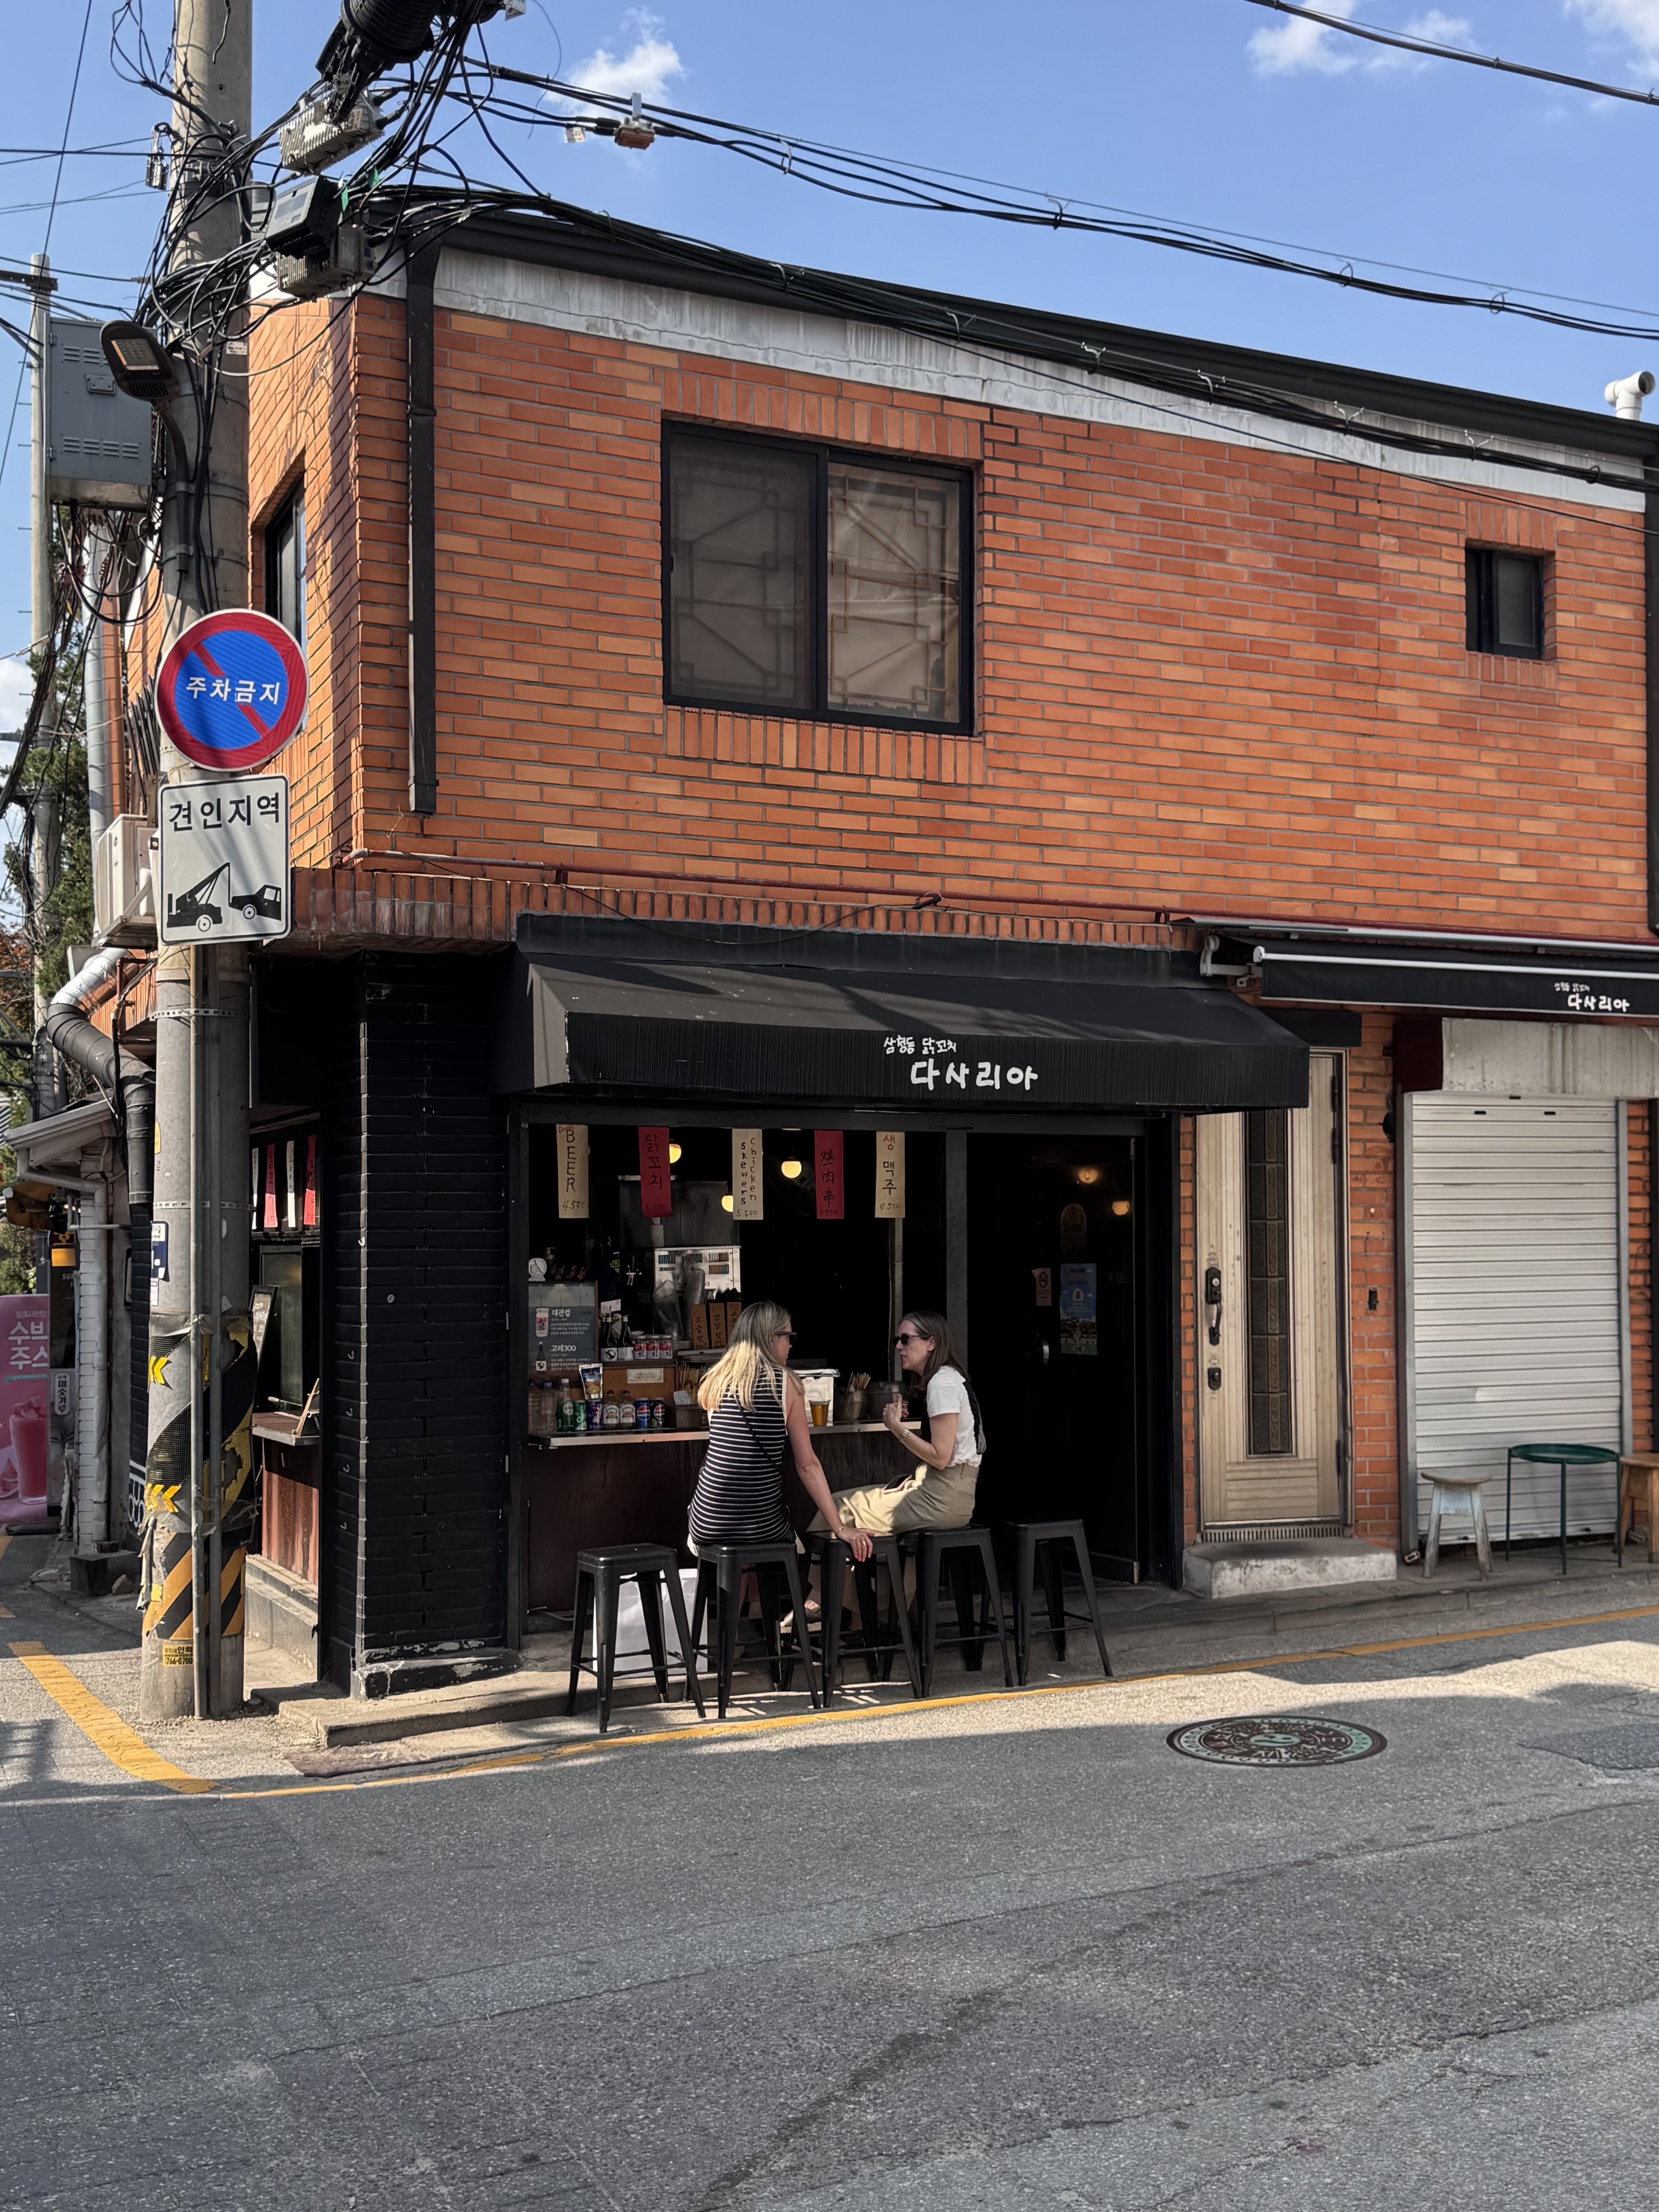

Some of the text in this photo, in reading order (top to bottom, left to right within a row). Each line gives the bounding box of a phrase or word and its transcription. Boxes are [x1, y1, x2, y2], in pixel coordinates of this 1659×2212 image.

[186, 677, 280, 705] 주차금지
[168, 791, 280, 832] 견인지역
[1567, 993, 1630, 1012] 다사리아
[883, 1034, 957, 1055] 삼청동 닭꼬치
[910, 1058, 1038, 1090] 다사리아
[566, 1129, 577, 1192] BEER
[645, 1134, 663, 1190] 닭꼬치
